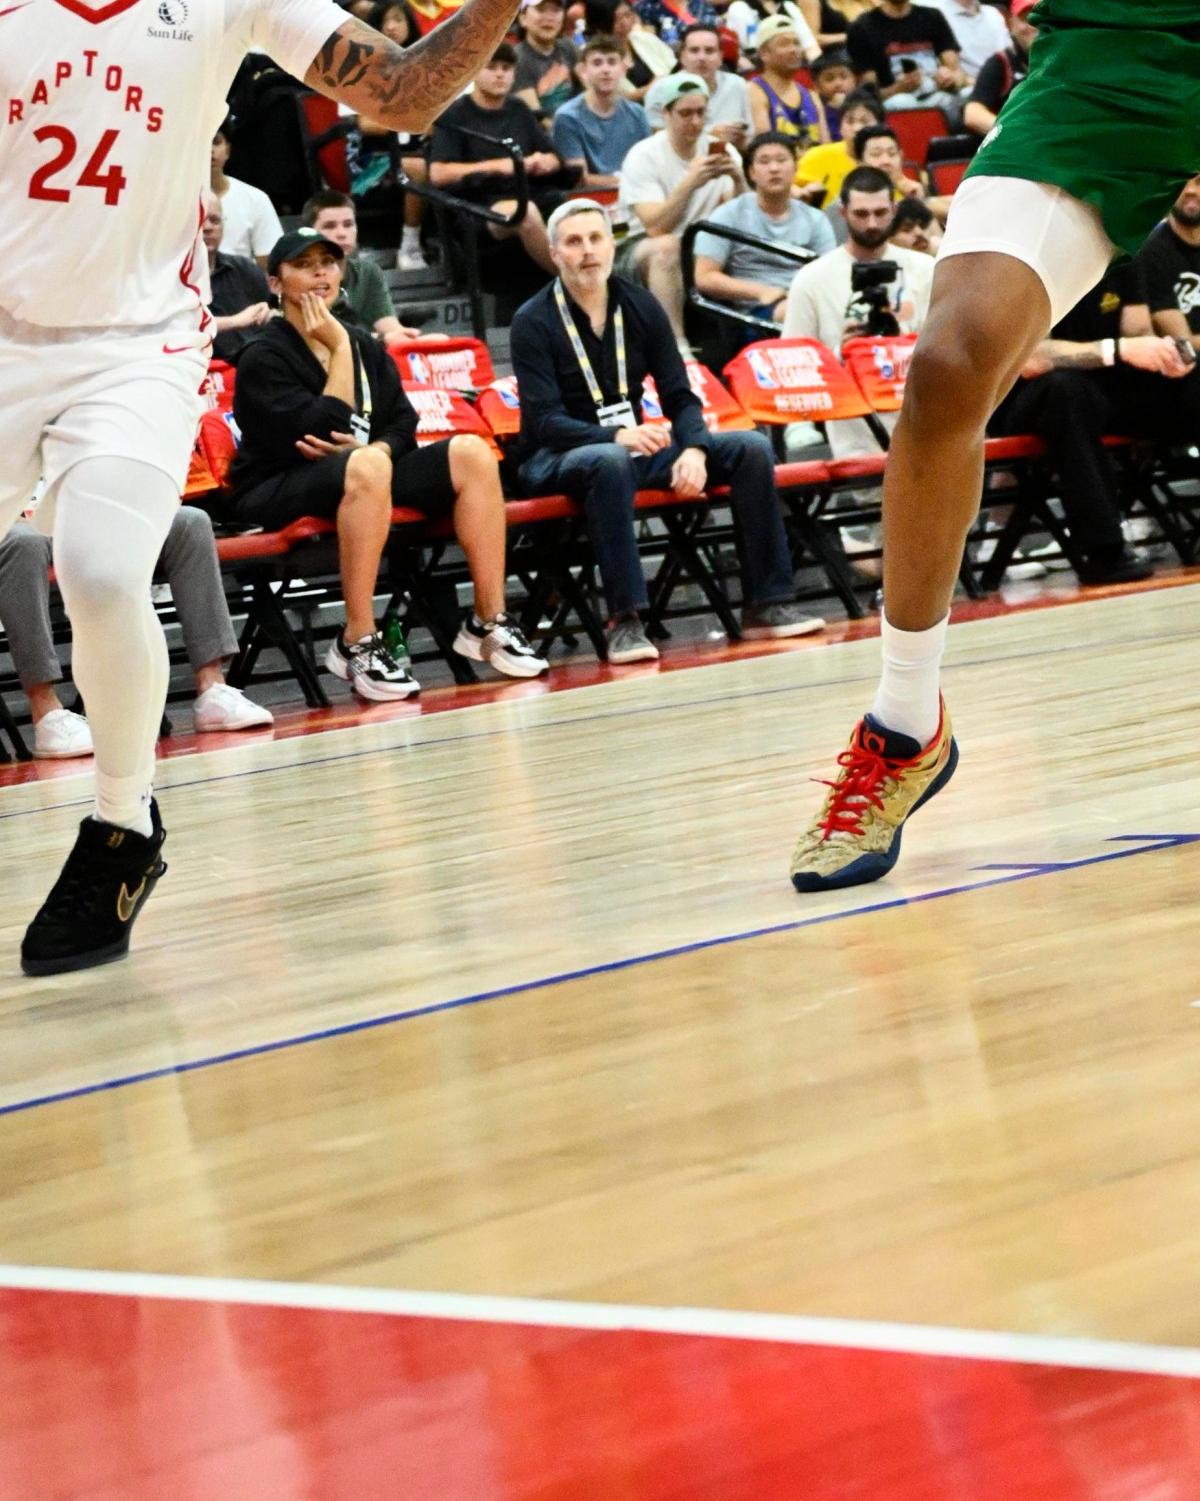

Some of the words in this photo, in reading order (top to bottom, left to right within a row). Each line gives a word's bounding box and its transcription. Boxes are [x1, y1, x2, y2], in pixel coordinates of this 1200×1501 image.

[146, 26, 170, 39] Sun
[172, 29, 194, 42] Life
[8, 50, 164, 133] RAPTORS
[28, 125, 127, 206] 24
